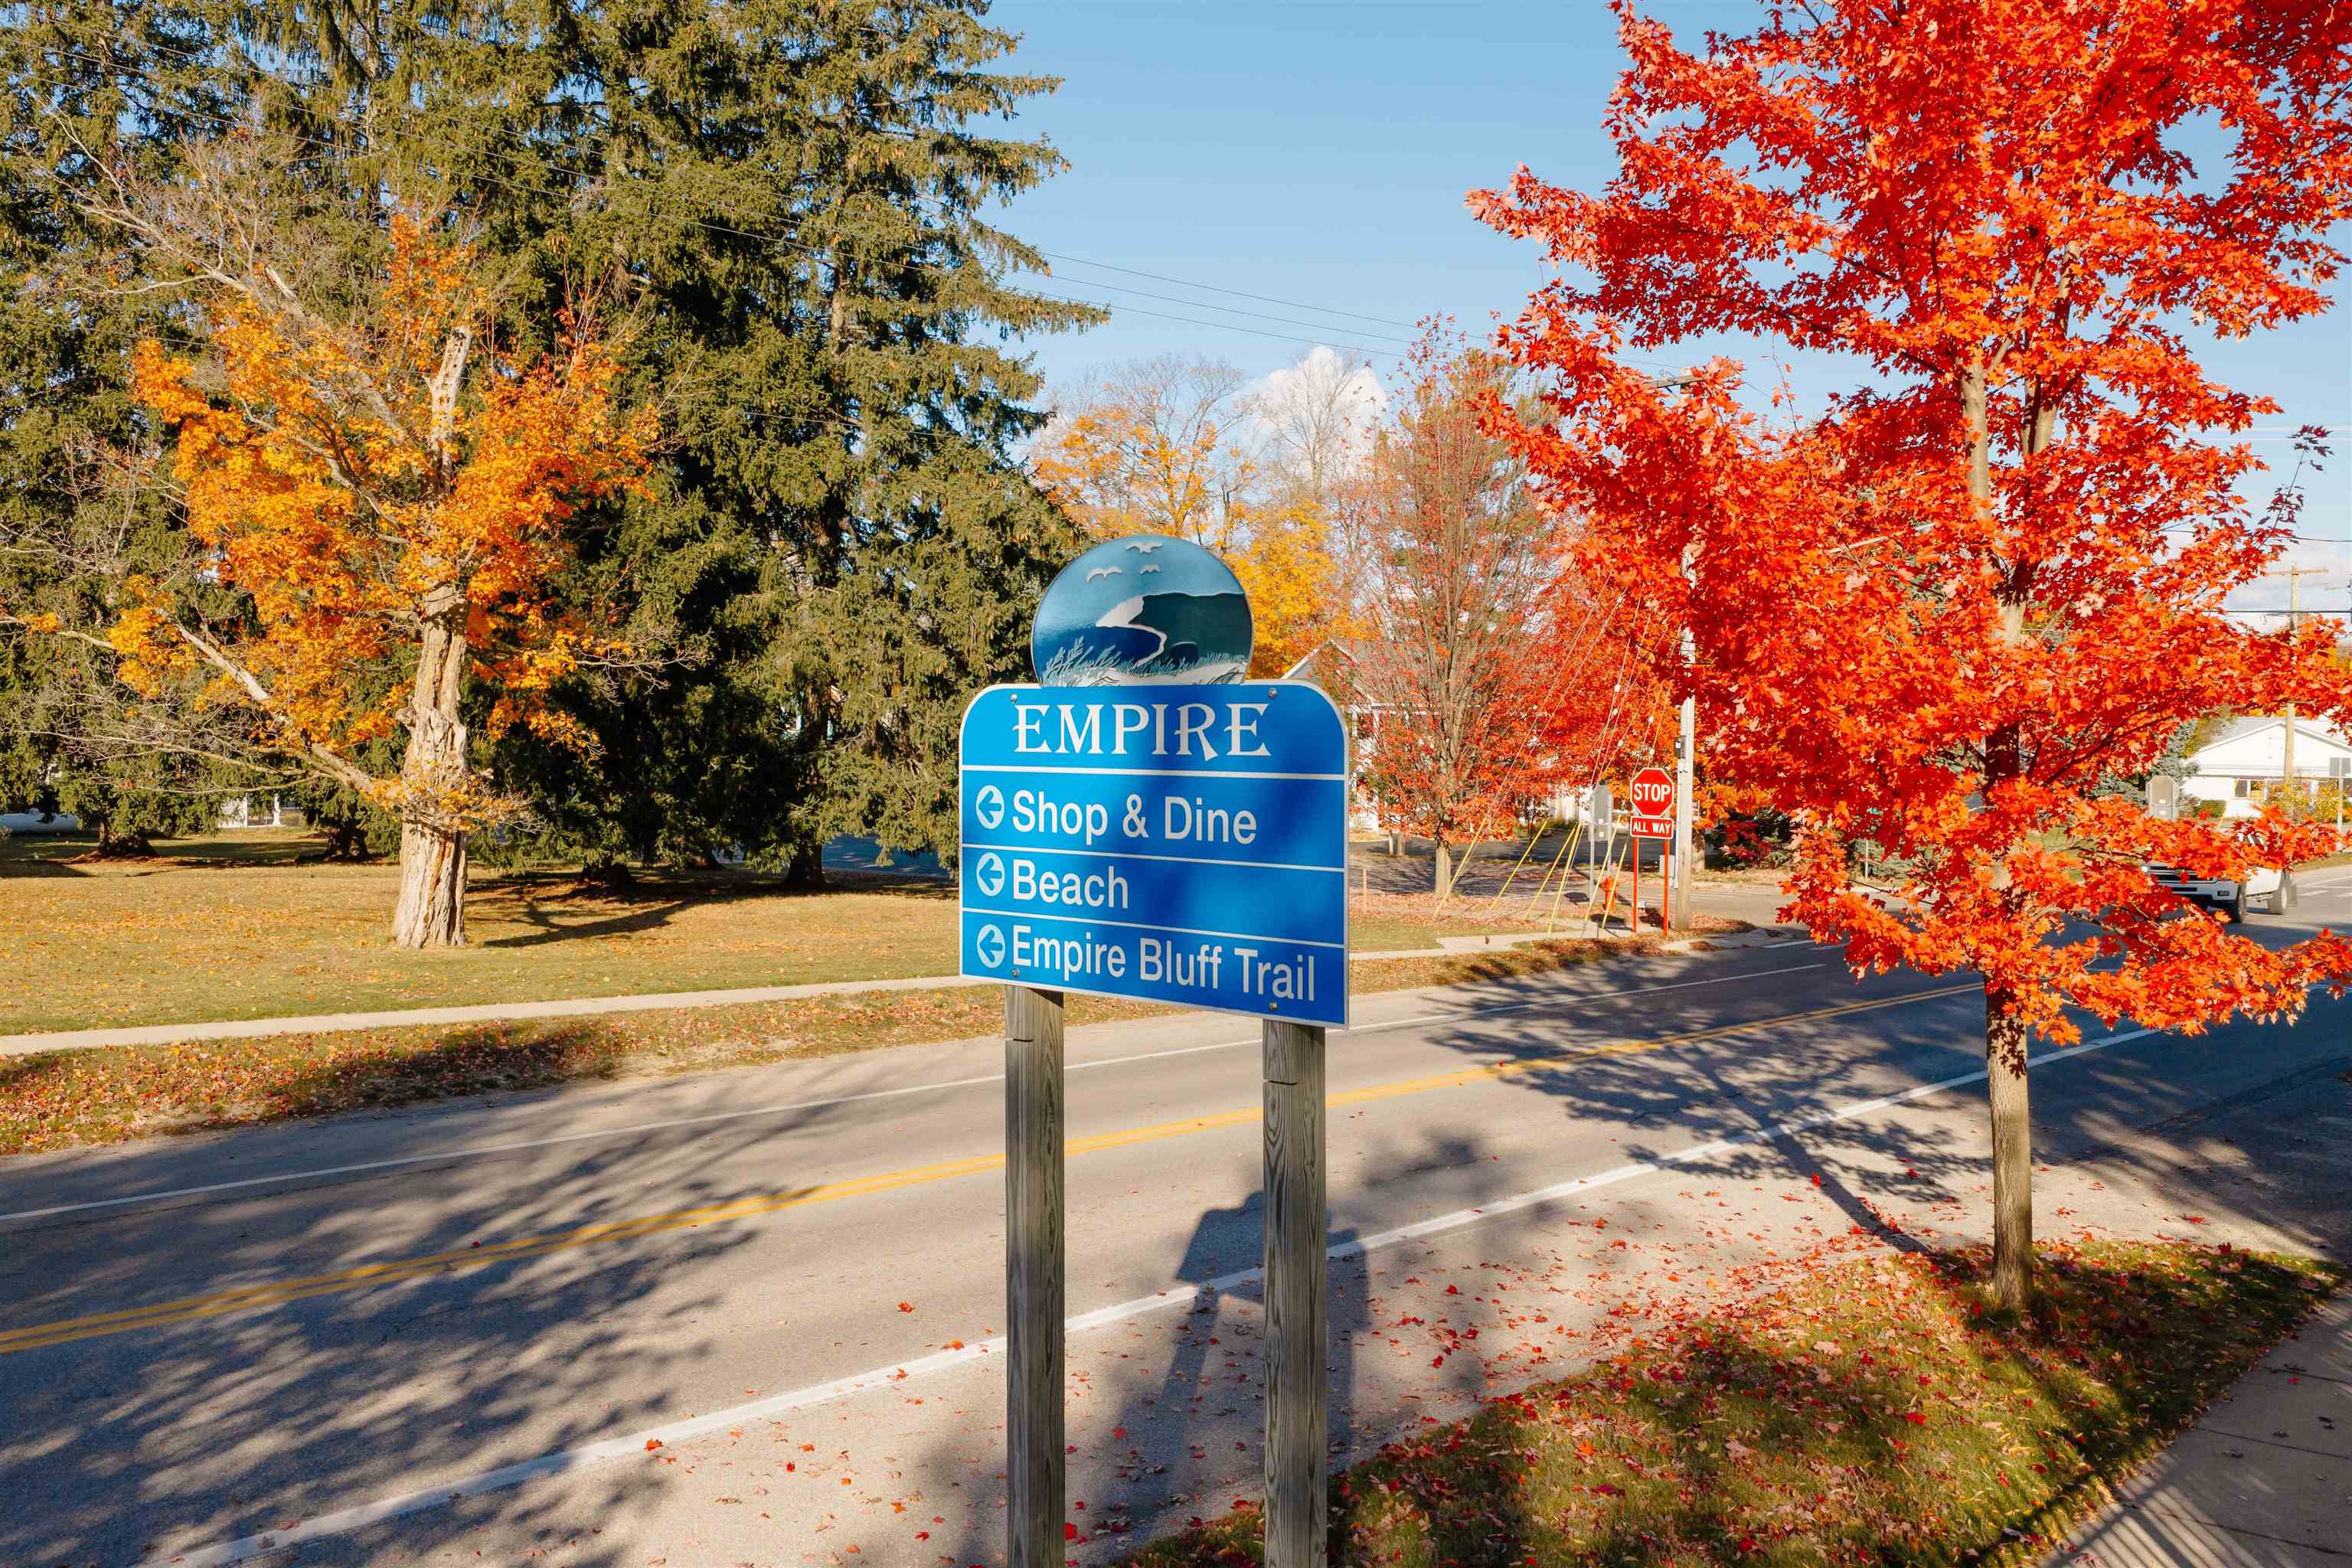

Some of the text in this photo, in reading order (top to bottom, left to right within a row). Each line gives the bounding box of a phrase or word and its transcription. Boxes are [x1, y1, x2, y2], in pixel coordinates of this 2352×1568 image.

[1011, 703, 1272, 761] EMPIRE
[1013, 790, 1257, 845] Shop & Dine
[1634, 784, 1671, 802] STOP
[1633, 822, 1671, 835] ALL WAY
[1013, 859, 1129, 910] Beach
[1012, 925, 1315, 1001] Empire Bluff Trail
